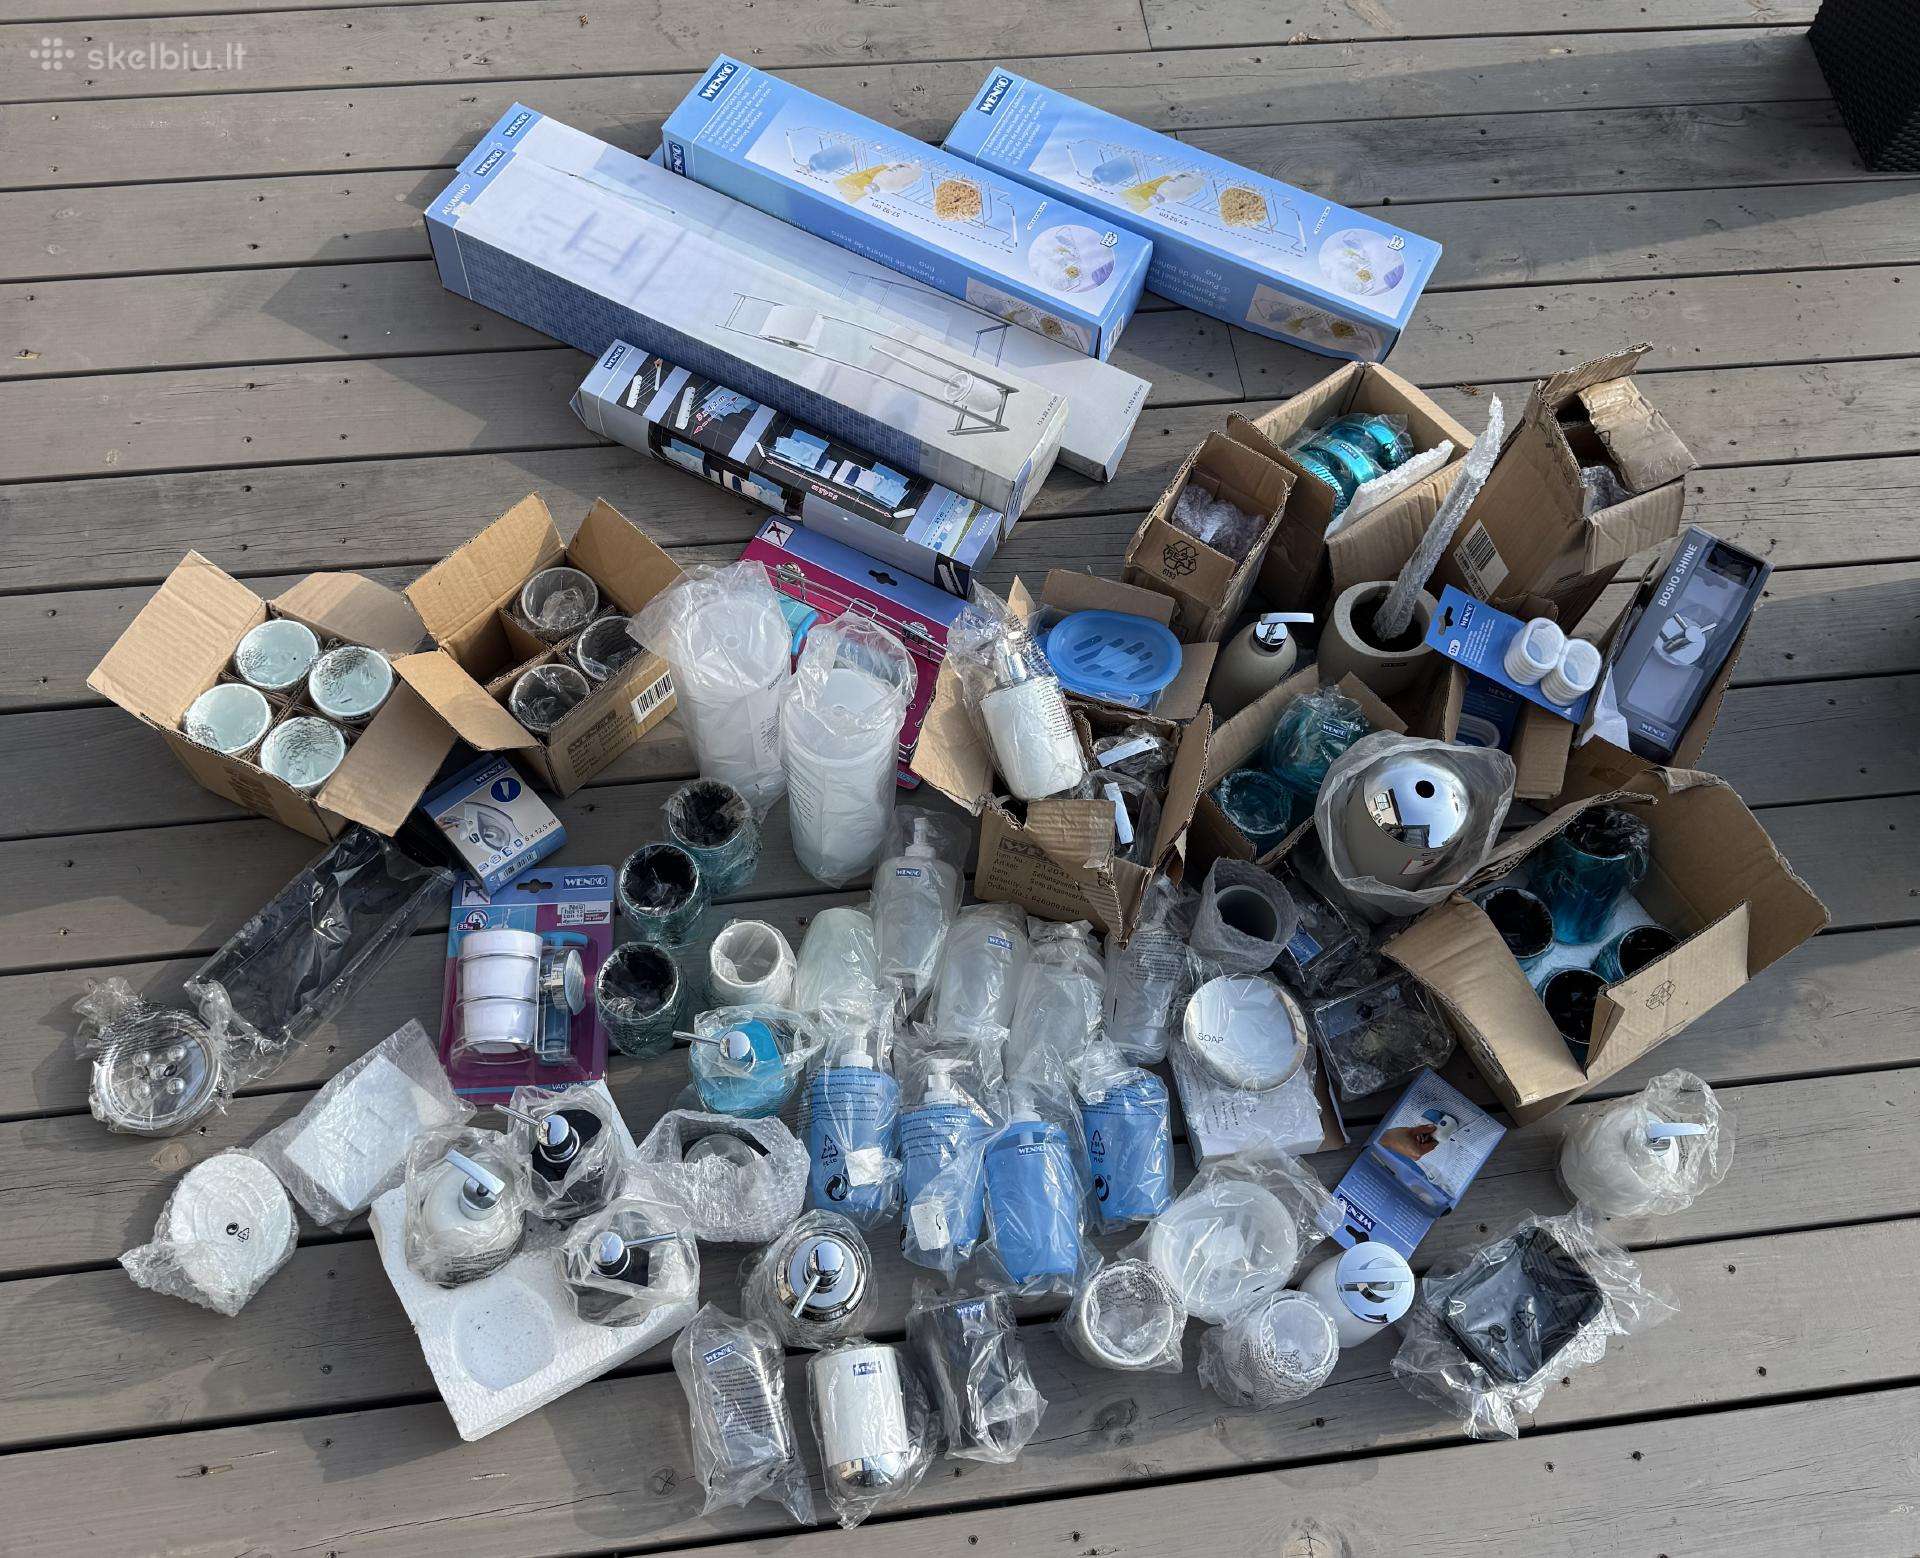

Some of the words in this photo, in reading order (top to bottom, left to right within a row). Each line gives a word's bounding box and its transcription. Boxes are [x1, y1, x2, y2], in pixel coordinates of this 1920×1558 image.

[701, 63, 735, 99] WENKO
[979, 77, 1009, 112] WENKO
[505, 111, 529, 138] WENKO
[476, 149, 503, 174] WENKO
[671, 144, 682, 173] ENKO
[441, 182, 470, 215] ALUMINIO
[604, 346, 624, 367] WENKO
[1657, 574, 1680, 607] BOSIO
[1674, 542, 1698, 575] SHINE
[1323, 724, 1346, 736] WENKO
[1641, 722, 1665, 737] WENKO
[475, 762, 506, 784] WENKO
[547, 817, 556, 826] ml
[564, 877, 605, 885] WENKO
[988, 936, 1012, 948] WENKO
[1197, 1032, 1223, 1043] SOAP
[1018, 1145, 1046, 1153] WENKO
[705, 1345, 734, 1361] WENKO
